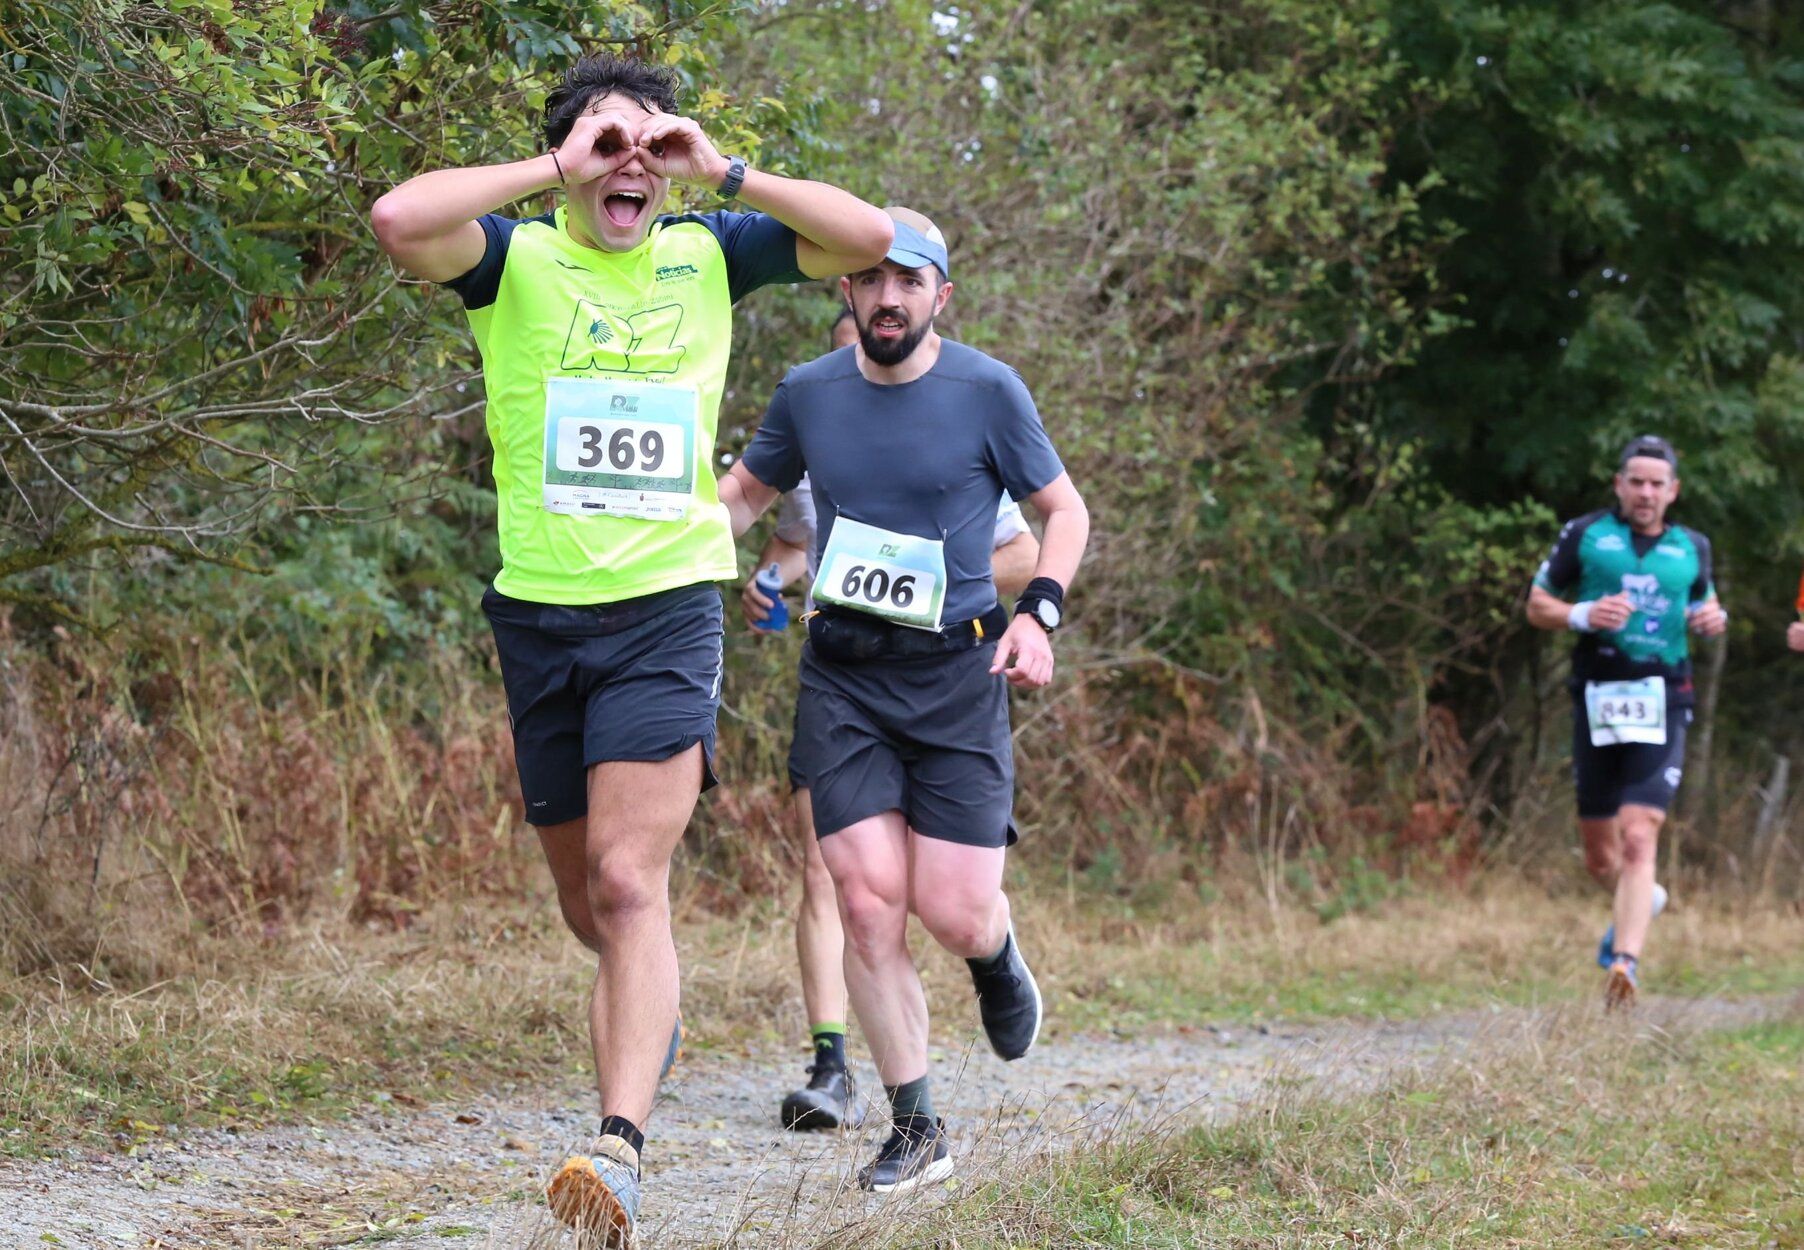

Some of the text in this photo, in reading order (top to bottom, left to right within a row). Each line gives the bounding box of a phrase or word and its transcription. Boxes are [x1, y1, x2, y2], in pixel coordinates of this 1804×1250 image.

[656, 267, 692, 281] Noticias
[577, 425, 665, 472] 369
[841, 565, 916, 609] 606
